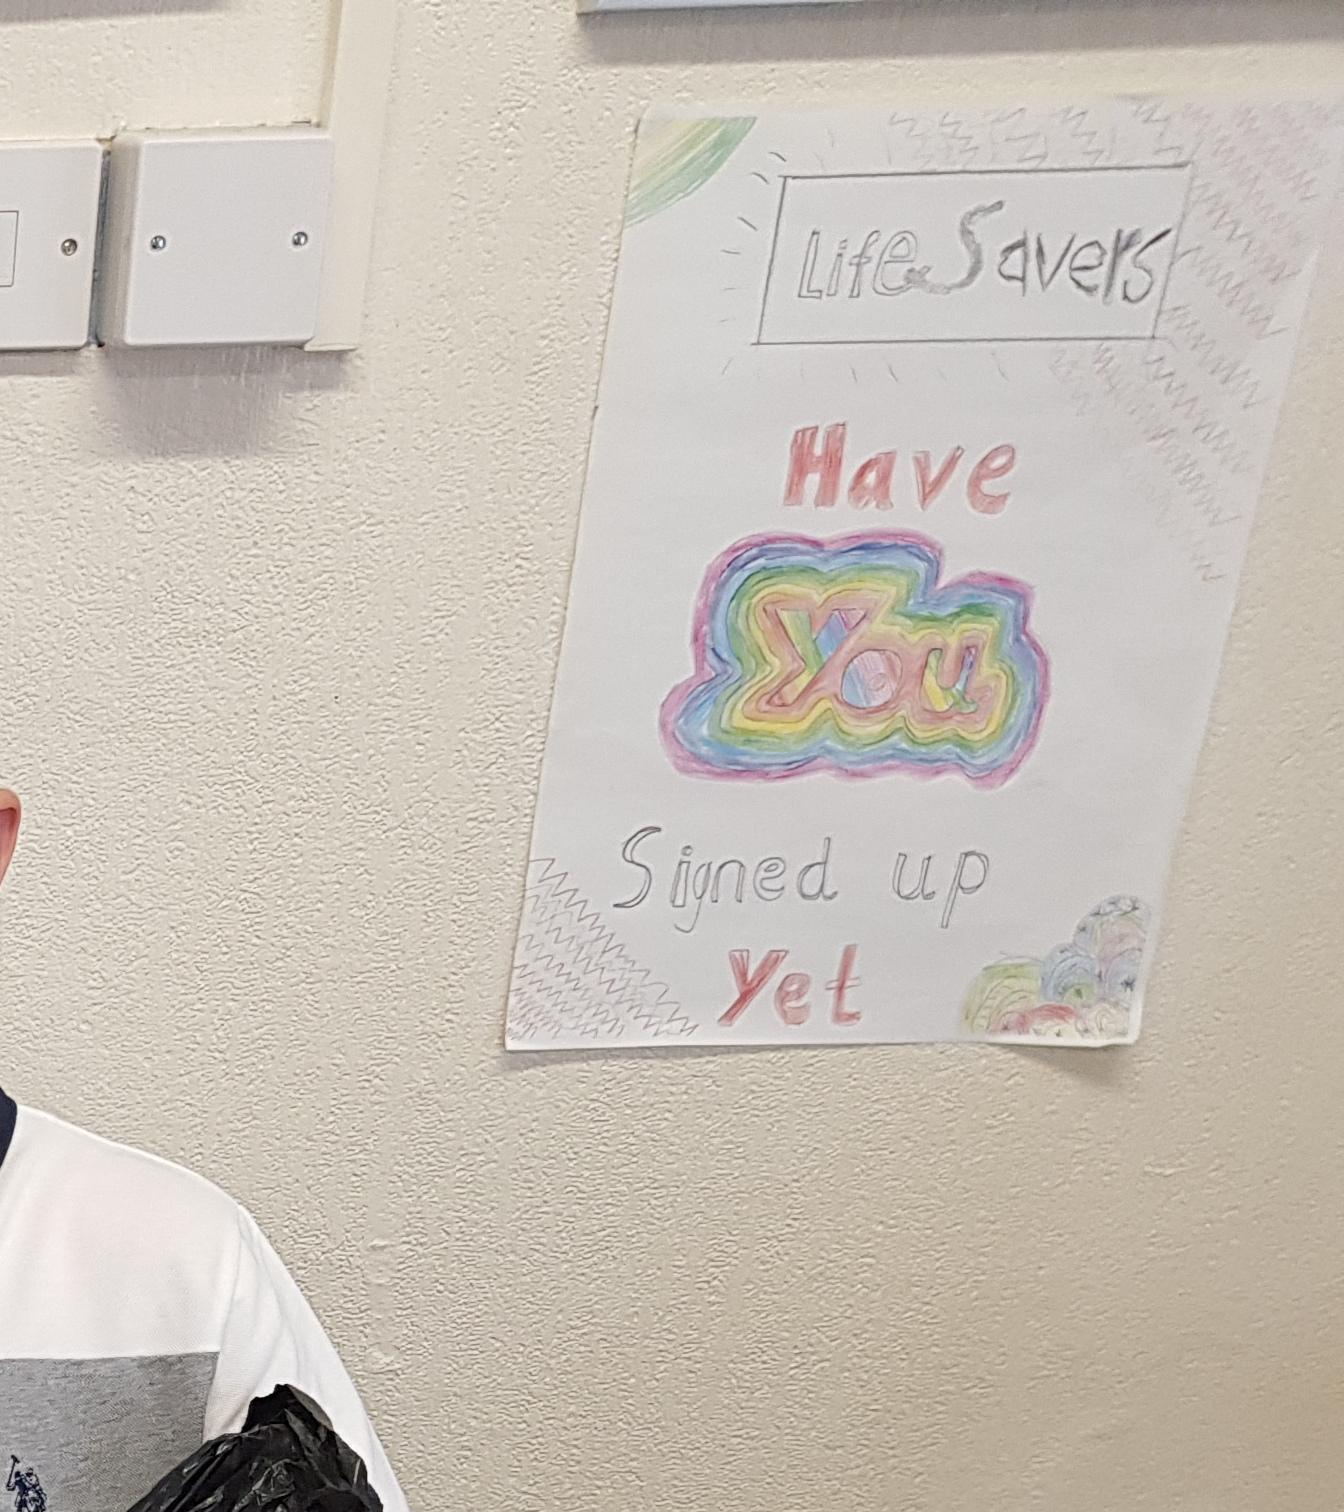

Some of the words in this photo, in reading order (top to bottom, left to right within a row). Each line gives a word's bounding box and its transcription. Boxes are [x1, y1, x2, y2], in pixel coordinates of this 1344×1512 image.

[798, 229, 918, 299] Life
[905, 199, 1172, 304] Savers
[784, 422, 1017, 514] Have
[740, 586, 1008, 724] You
[613, 826, 839, 932] Signed
[892, 848, 992, 928] up
[718, 943, 862, 1027] Yet
